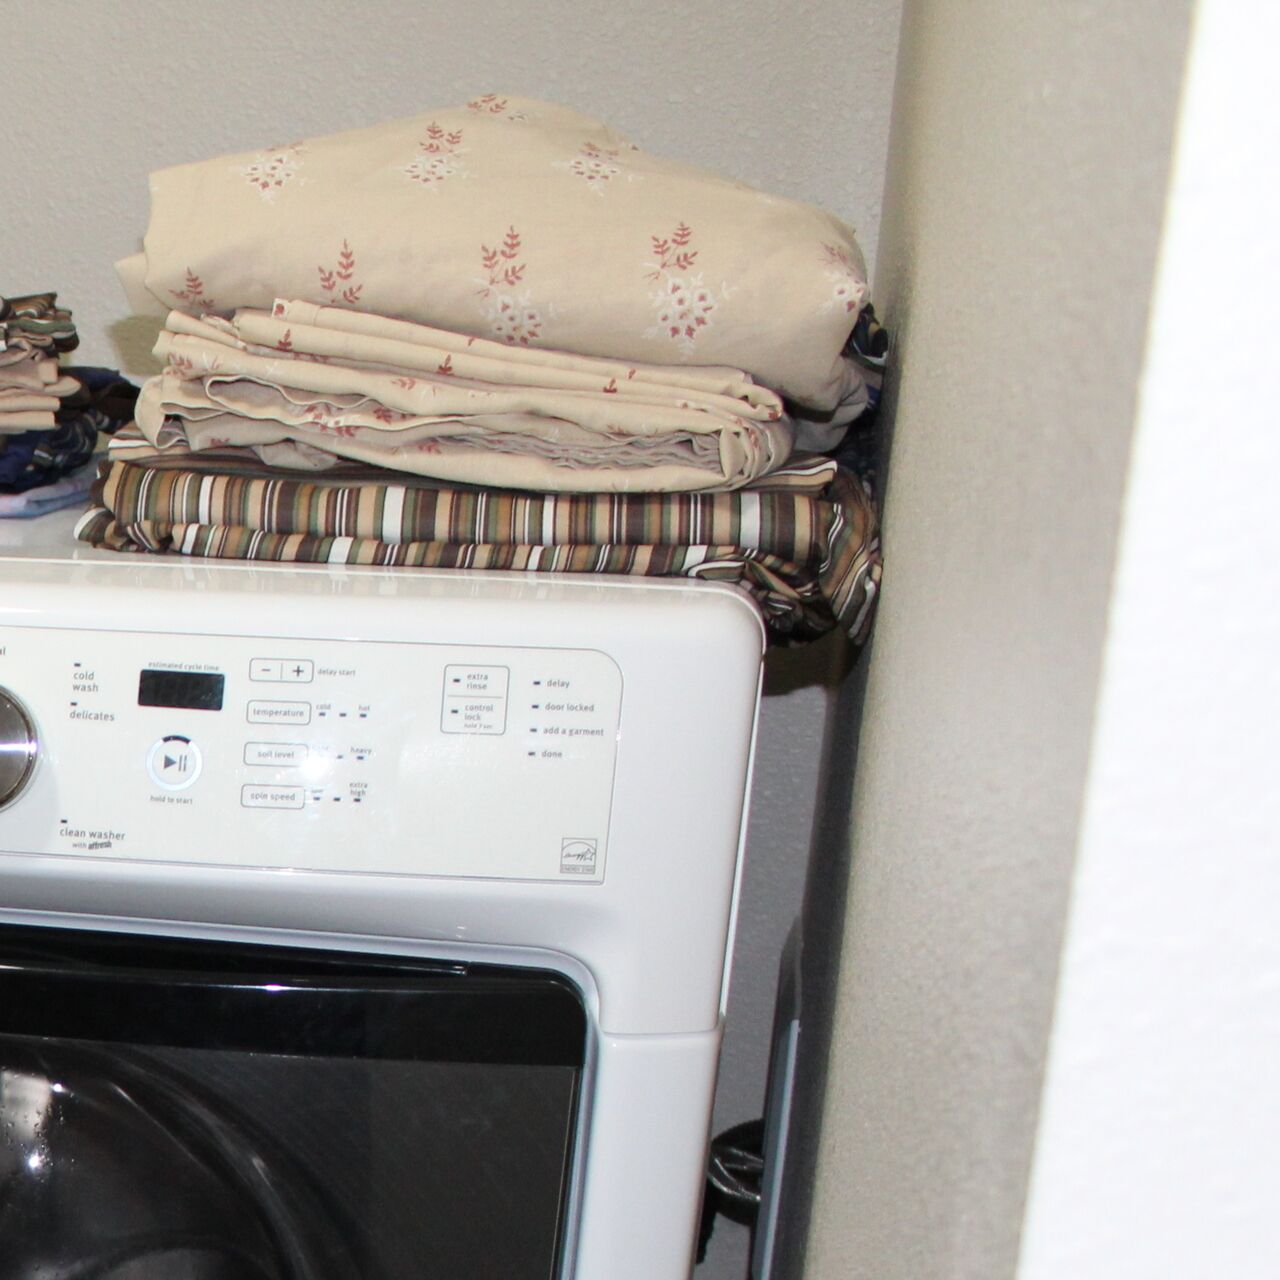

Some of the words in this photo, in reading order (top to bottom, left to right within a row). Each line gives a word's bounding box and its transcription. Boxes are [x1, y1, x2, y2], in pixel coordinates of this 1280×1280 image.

[148, 661, 183, 670] estimated
[184, 663, 202, 671] cycle
[203, 663, 219, 671] time
[73, 671, 95, 681] cold
[467, 672, 489, 681] extra
[72, 682, 99, 693] wash
[466, 681, 487, 690] rinse
[546, 679, 570, 689] delay
[465, 704, 494, 712] control
[545, 703, 565, 712] door
[566, 703, 595, 712] locked
[69, 710, 115, 721] delicates
[253, 708, 304, 718] temperature
[464, 713, 481, 721] lock
[543, 726, 560, 735] add
[569, 728, 604, 737] garment
[257, 750, 272, 758] soil
[274, 750, 295, 758] level
[541, 750, 563, 758] done
[150, 795, 166, 803] hold
[176, 797, 193, 805] start
[250, 792, 268, 802] spin
[270, 792, 296, 802] speed
[60, 827, 86, 838] clean
[88, 829, 126, 841] washer
